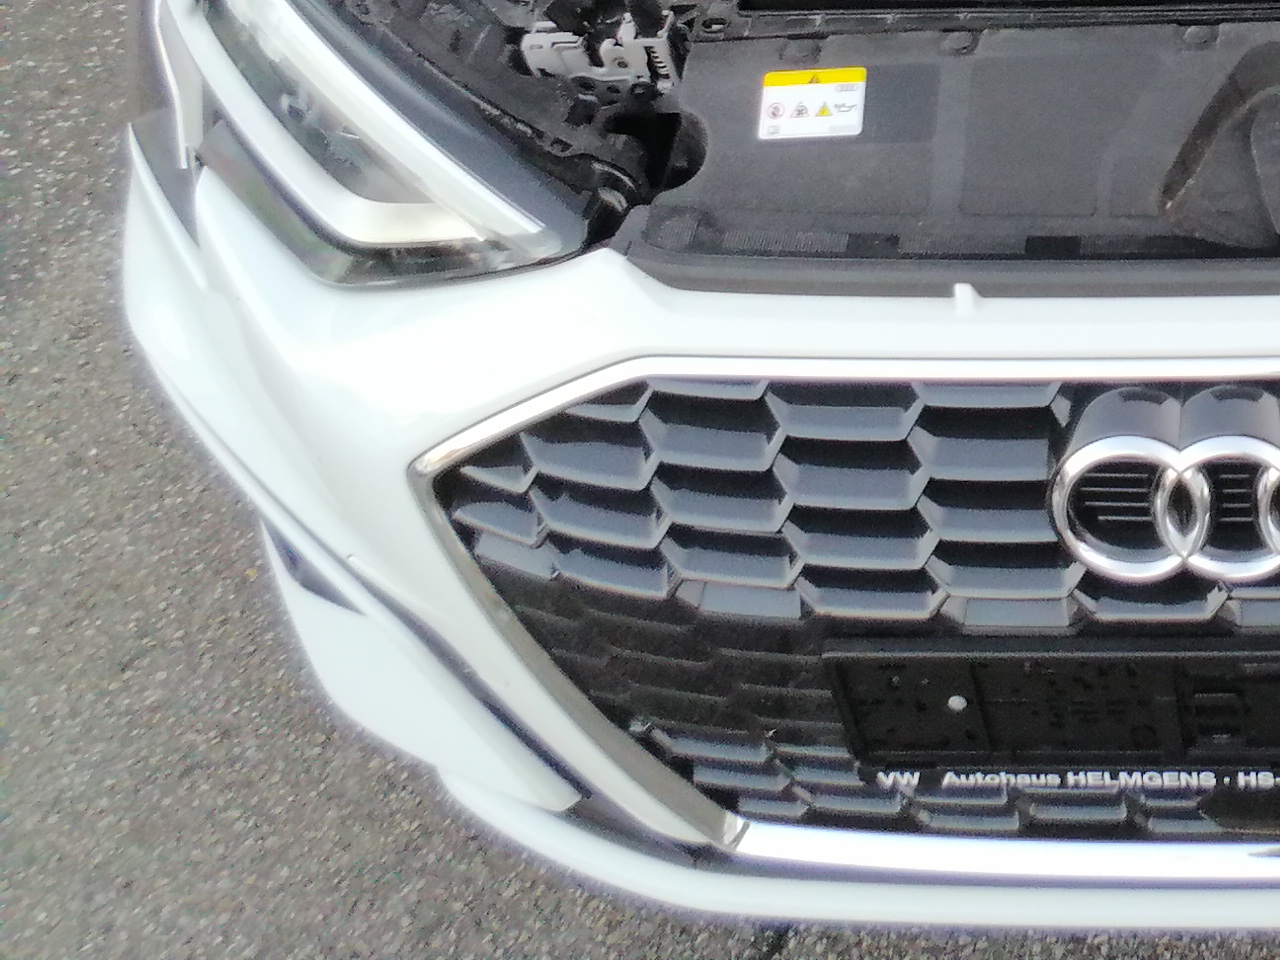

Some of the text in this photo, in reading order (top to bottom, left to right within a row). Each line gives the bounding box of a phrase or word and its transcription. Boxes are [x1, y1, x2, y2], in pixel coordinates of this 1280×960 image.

[877, 771, 921, 787] VW
[941, 771, 1062, 787] Autohaus
[1067, 771, 1217, 787] HELMGENS
